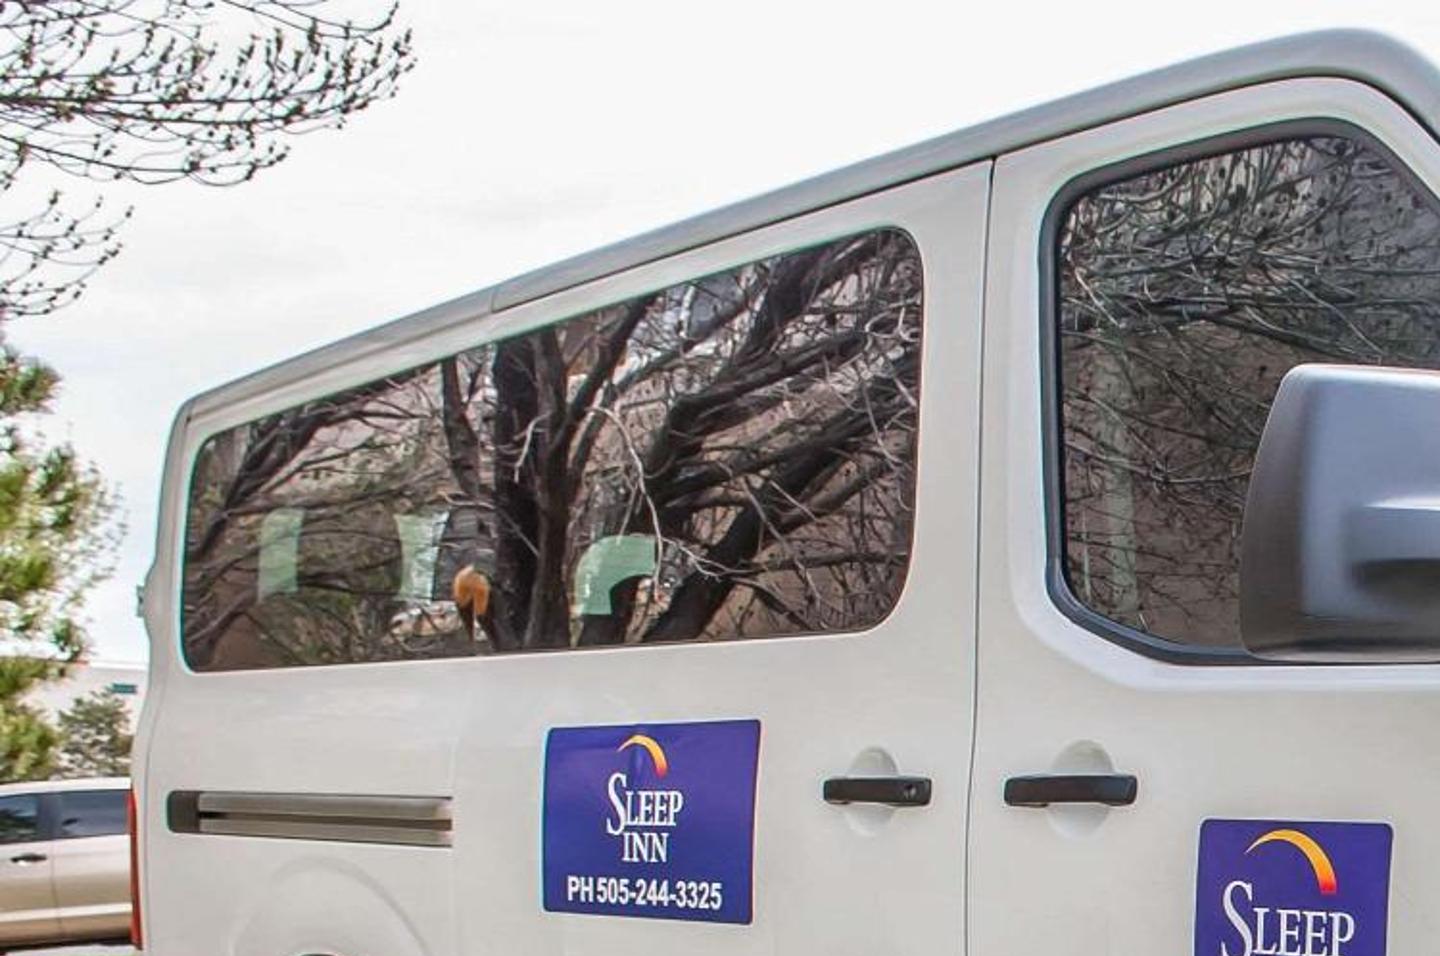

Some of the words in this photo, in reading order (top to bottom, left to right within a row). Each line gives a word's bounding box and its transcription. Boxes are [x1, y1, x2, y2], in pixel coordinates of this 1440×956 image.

[606, 772, 684, 836] SLEEP
[621, 832, 669, 863] INN
[567, 875, 594, 904] PH
[596, 876, 722, 910] 505-244-3325
